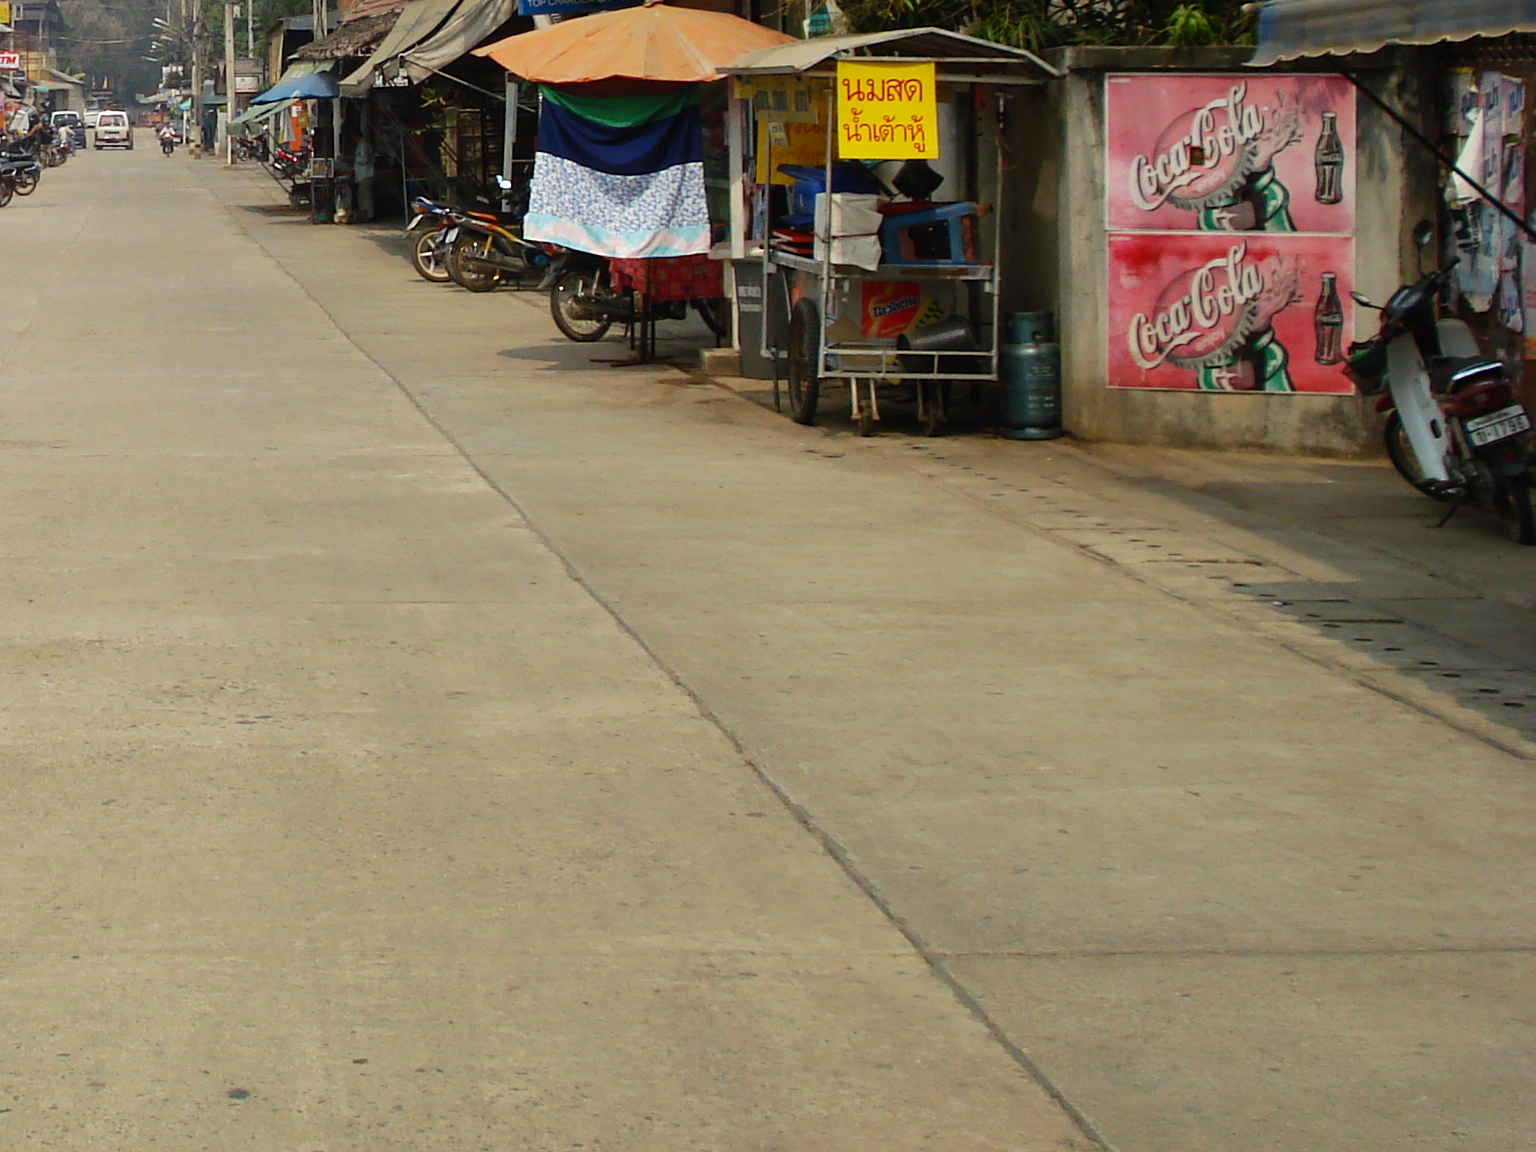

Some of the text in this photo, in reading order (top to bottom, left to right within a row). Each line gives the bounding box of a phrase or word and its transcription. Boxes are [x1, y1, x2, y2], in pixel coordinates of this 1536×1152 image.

[842, 78, 923, 102] นมสด
[843, 107, 926, 153] น้ำเต้าหู้
